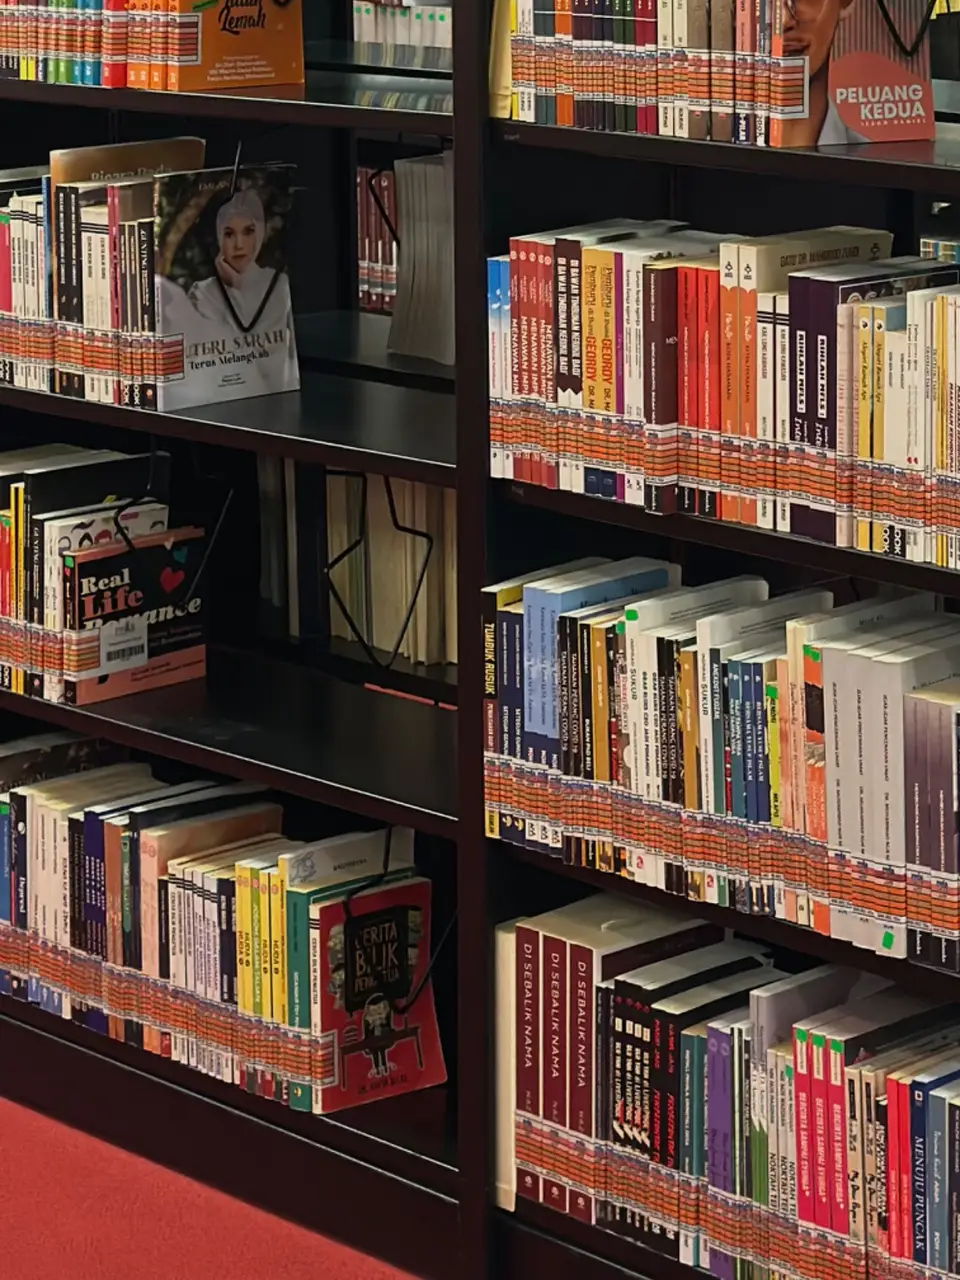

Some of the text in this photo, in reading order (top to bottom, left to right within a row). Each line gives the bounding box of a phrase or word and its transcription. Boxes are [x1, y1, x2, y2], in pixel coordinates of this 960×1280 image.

[836, 84, 923, 105] PELUANG
[861, 102, 926, 120] KEDUA
[586, 336, 597, 381] GEORDY
[602, 338, 613, 385] GEORDY
[80, 567, 131, 596] Real
[81, 585, 144, 620] Life
[83, 597, 202, 631] ance
[484, 623, 495, 695] TUMBUK RUSUK
[631, 668, 639, 700] SUKUR
[701, 684, 709, 715] SUKUR
[355, 921, 398, 948] ERITA
[523, 943, 533, 1067] DI SEBALIK NAMA
[550, 952, 560, 1077] DI SEBALIK NAMA
[577, 961, 587, 1087] DI SEBALIK NAMA
[769, 1153, 777, 1190] NOKTAH
[780, 1156, 788, 1191] NOKTAH
[914, 1136, 925, 1251] MENUJU PUNCAK
